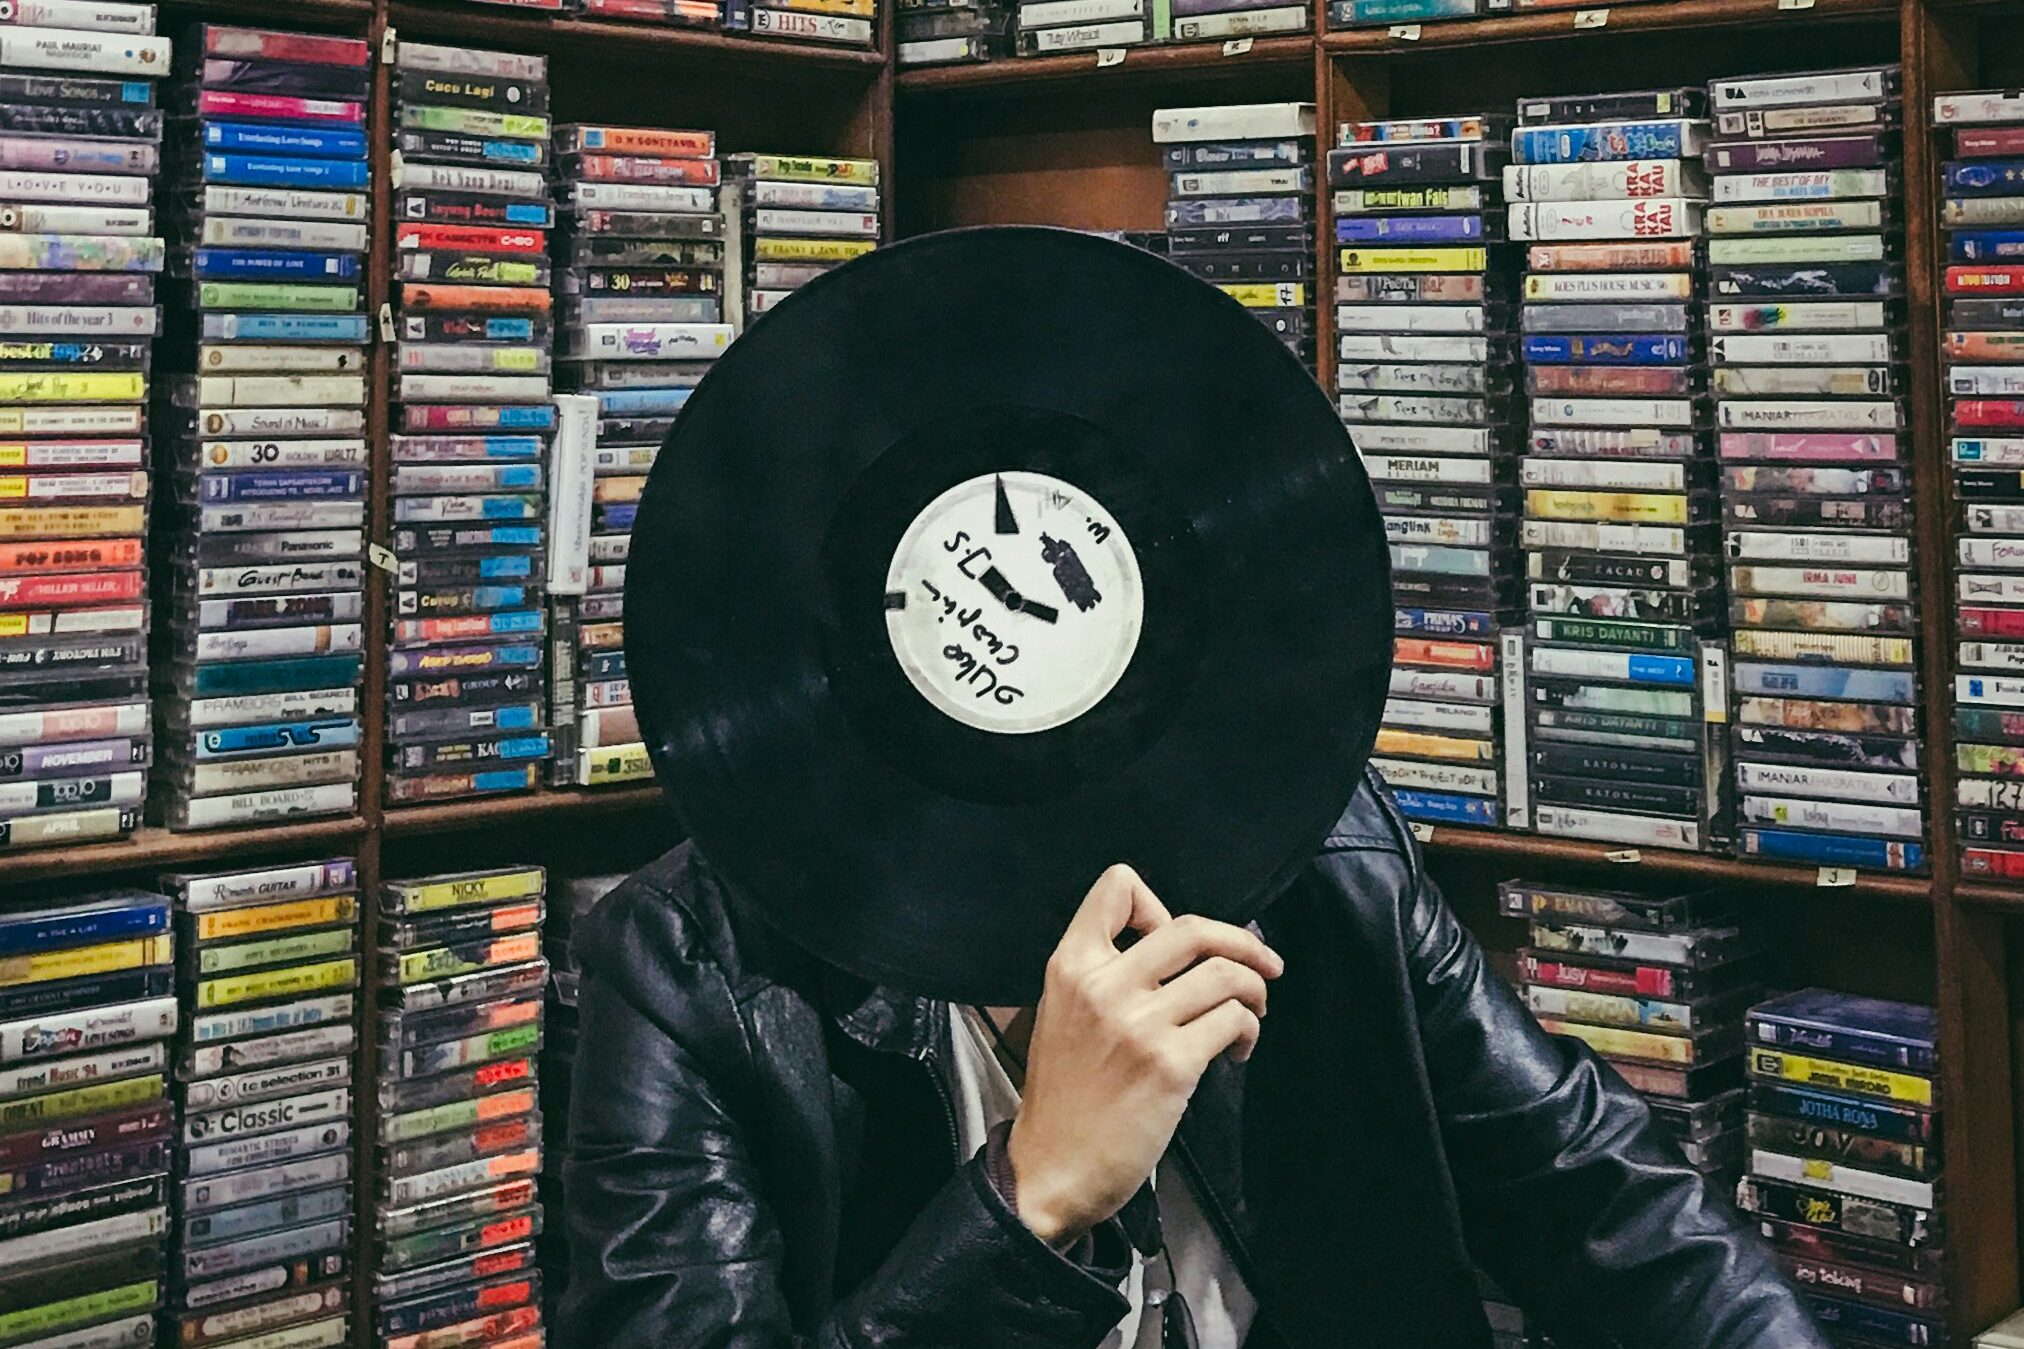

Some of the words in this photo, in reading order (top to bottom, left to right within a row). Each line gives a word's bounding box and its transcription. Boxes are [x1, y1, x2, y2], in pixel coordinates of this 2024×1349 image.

[1388, 459, 1440, 473] MERIAM
[43, 820, 81, 836] APRIL
[451, 880, 486, 896] NICKY
[220, 1101, 295, 1132] Classic
